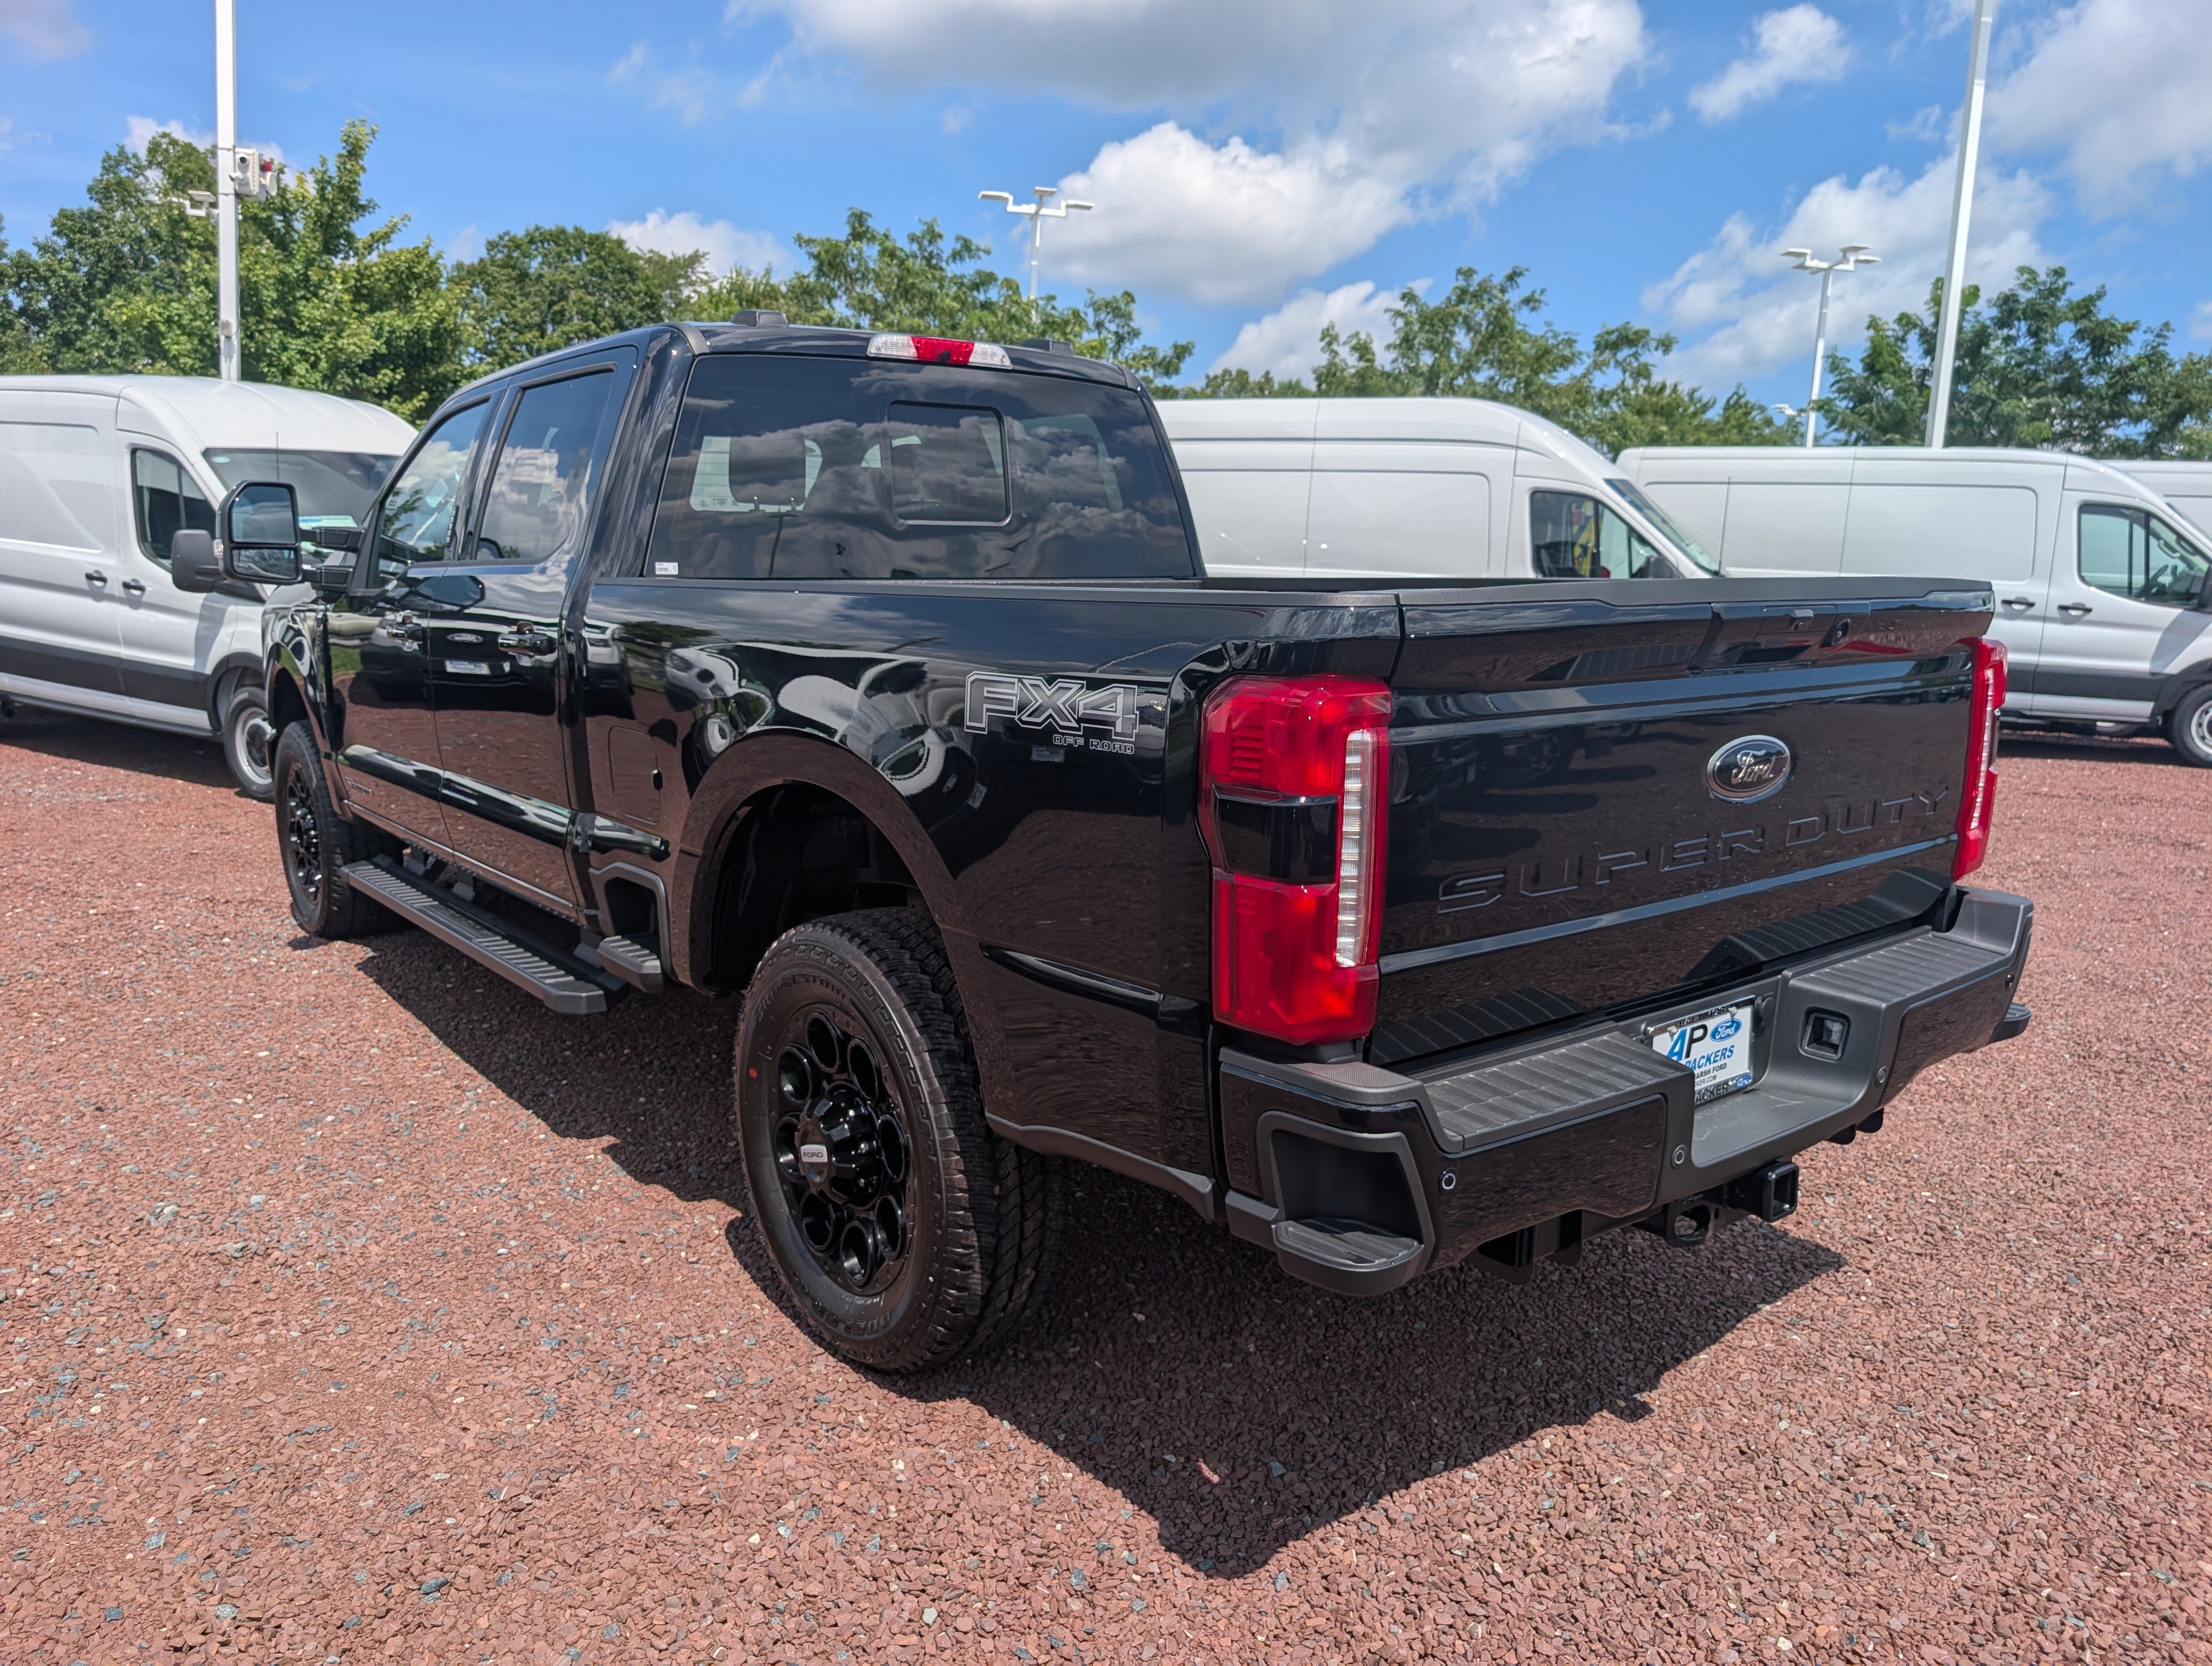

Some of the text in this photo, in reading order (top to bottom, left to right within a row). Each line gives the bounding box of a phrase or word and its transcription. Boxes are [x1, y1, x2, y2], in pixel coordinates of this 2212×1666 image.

[964, 671, 1139, 741] FX4
[1053, 734, 1134, 755] OFF ROAD
[1731, 749, 1776, 784] Ford
[1437, 785, 1951, 914] SUPER DUTY
[1715, 1021, 1736, 1040] Ford
[1667, 1024, 1708, 1062] AP
[1684, 1045, 1734, 1071] PACKERS
[1695, 1074, 1717, 1085] KER.COM
[1696, 1062, 1727, 1079] ARSH FORD
[1695, 1081, 1728, 1104] ACKER
